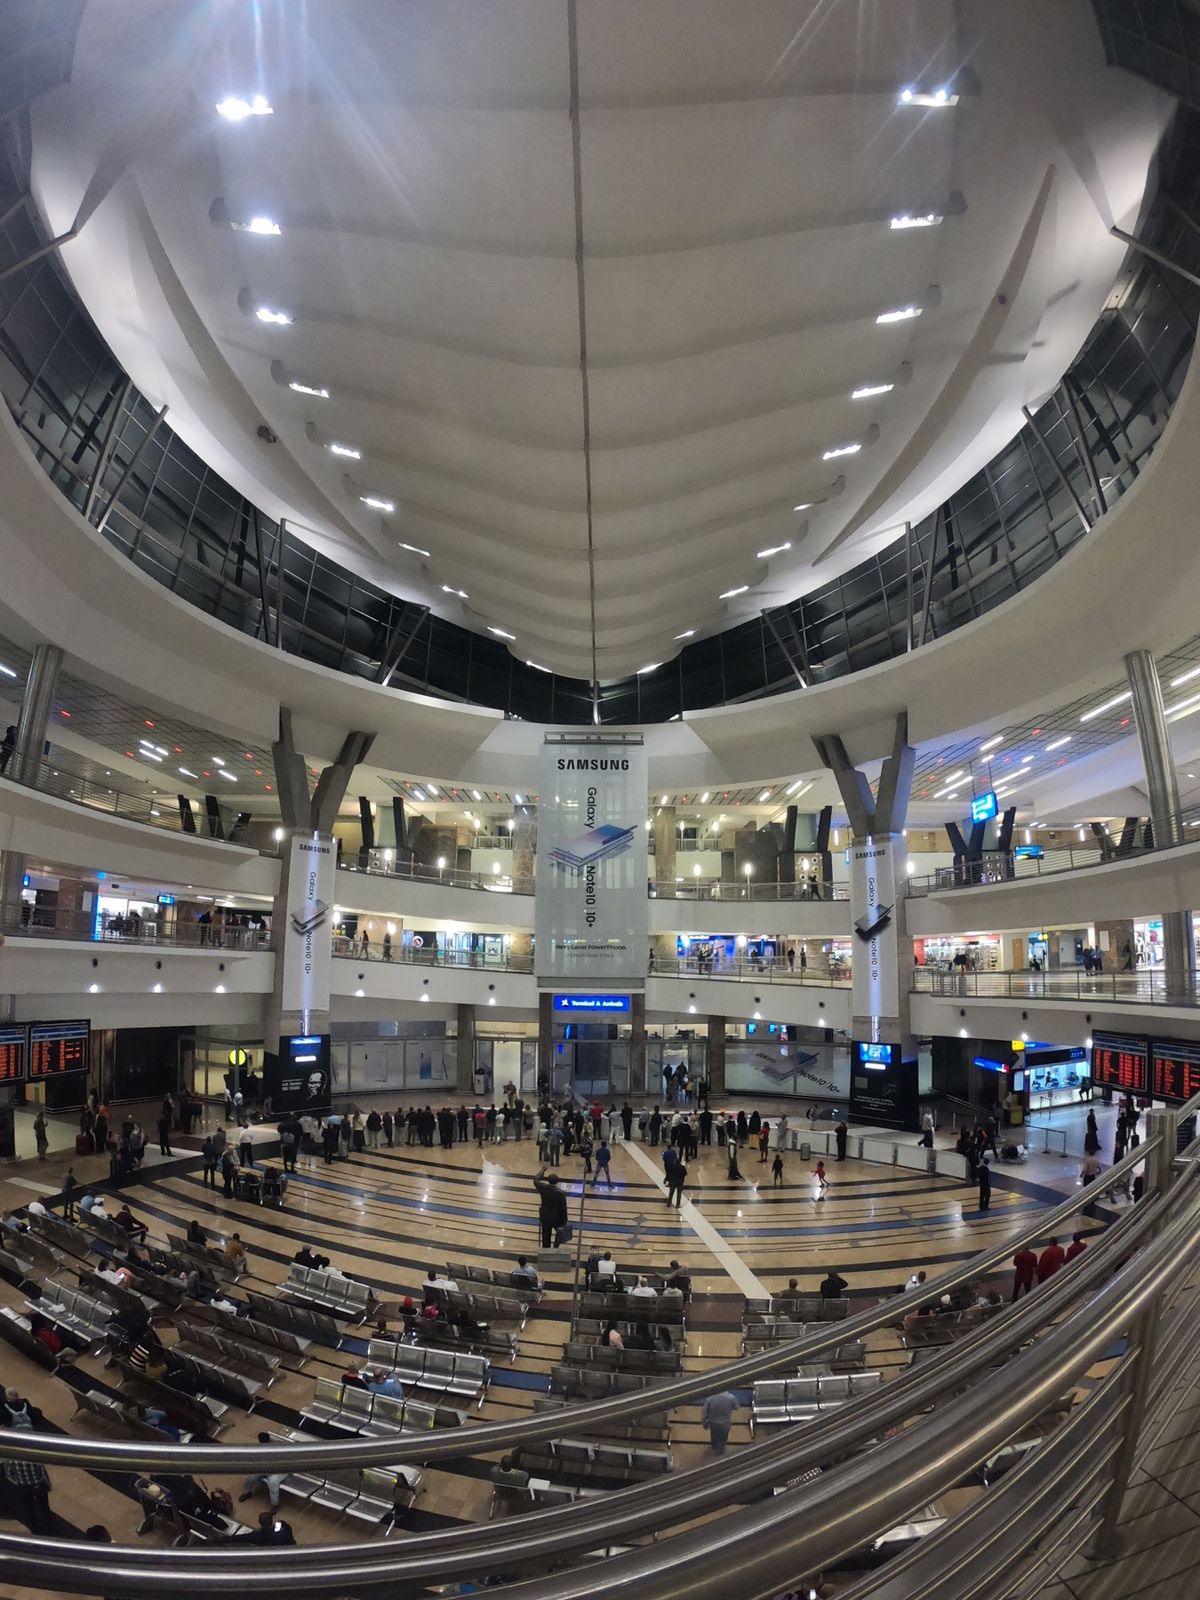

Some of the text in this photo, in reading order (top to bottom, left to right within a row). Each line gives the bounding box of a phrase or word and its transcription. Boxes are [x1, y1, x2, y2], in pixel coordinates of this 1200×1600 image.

[557, 759, 630, 771] SAMSUNG
[584, 787, 597, 829] Galaxy
[299, 844, 330, 854] SAMSUNG
[855, 849, 886, 859] SAMSUNG
[307, 871, 317, 901] Galaxy
[586, 866, 596, 905] Note10
